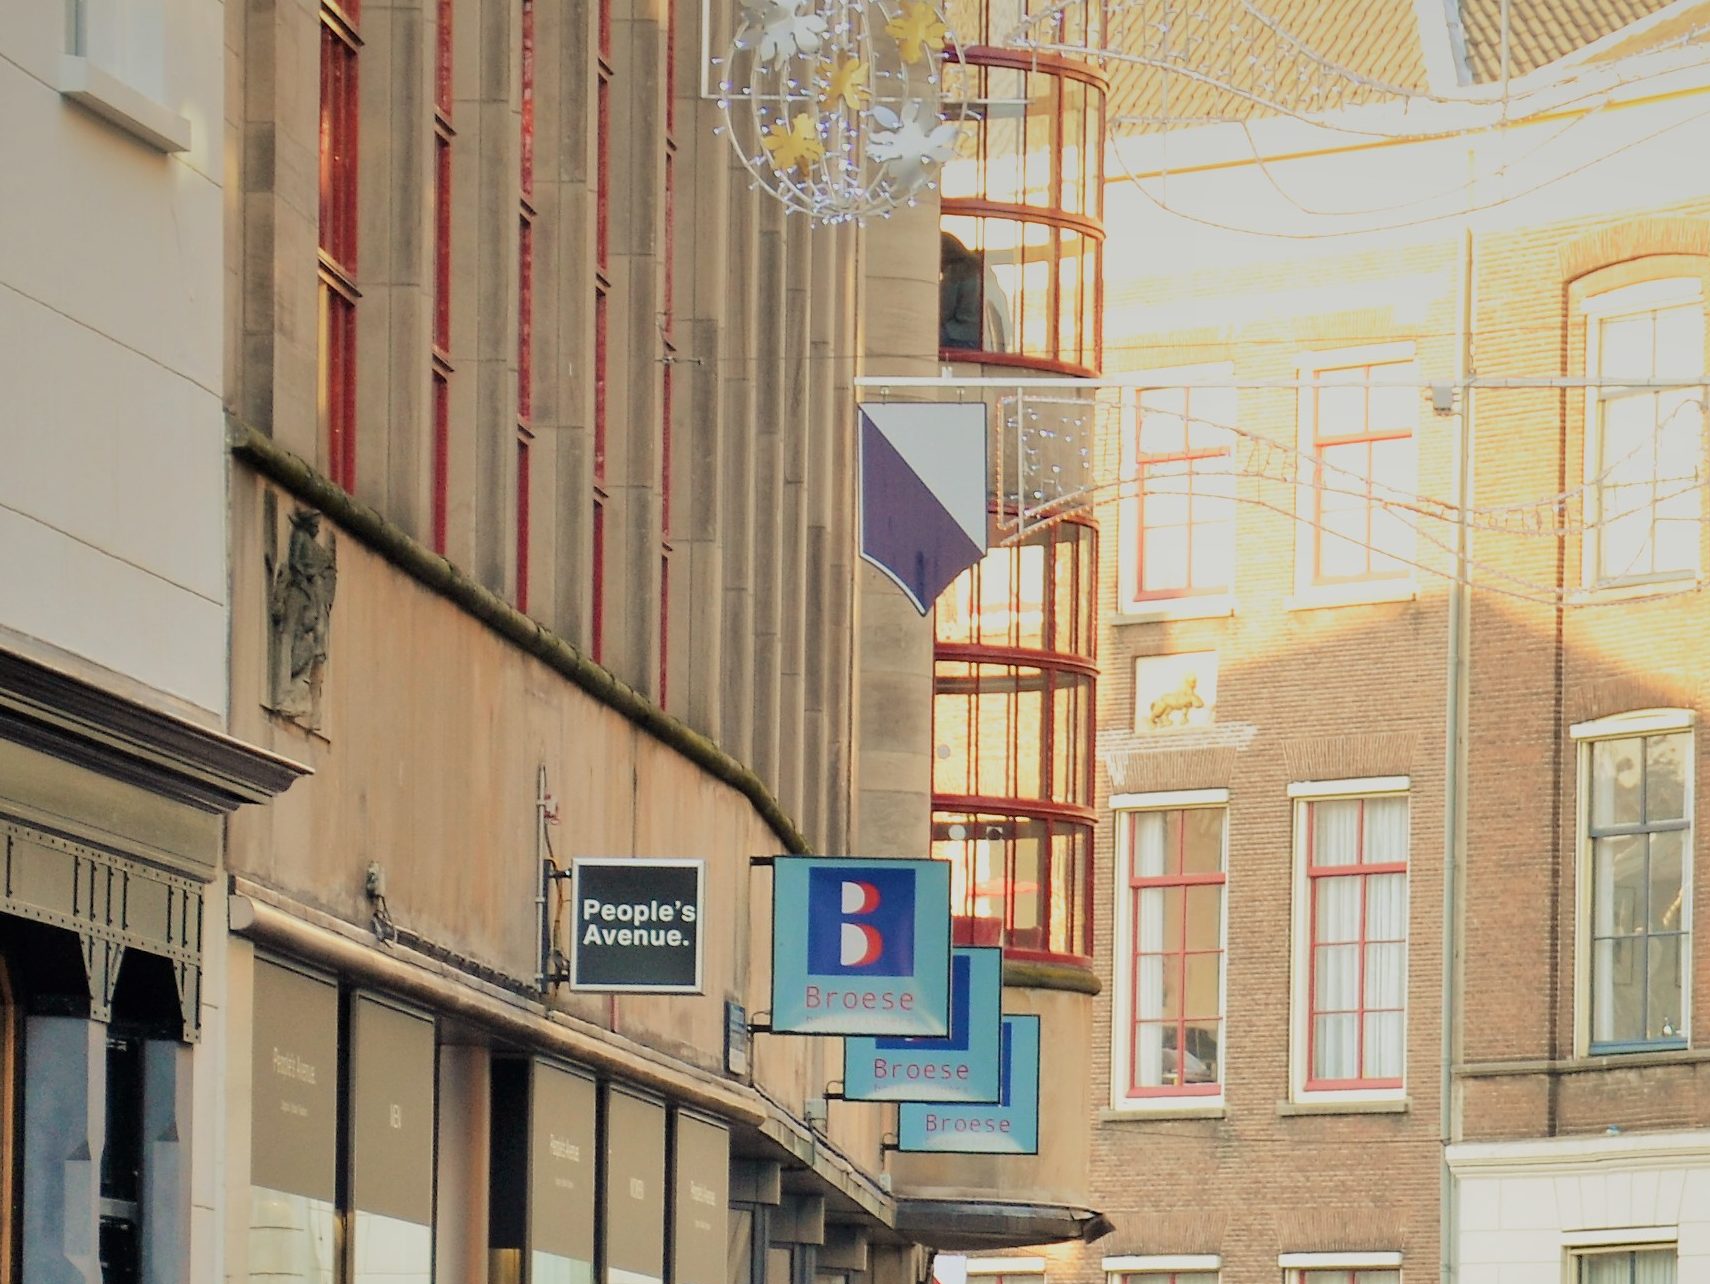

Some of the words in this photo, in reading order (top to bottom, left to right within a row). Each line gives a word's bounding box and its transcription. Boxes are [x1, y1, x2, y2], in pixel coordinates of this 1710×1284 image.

[583, 898, 696, 927] People's
[582, 923, 690, 947] Avenue.
[806, 985, 915, 1011] Broese
[874, 1058, 970, 1080] Broese
[926, 1114, 1011, 1133] Broese
